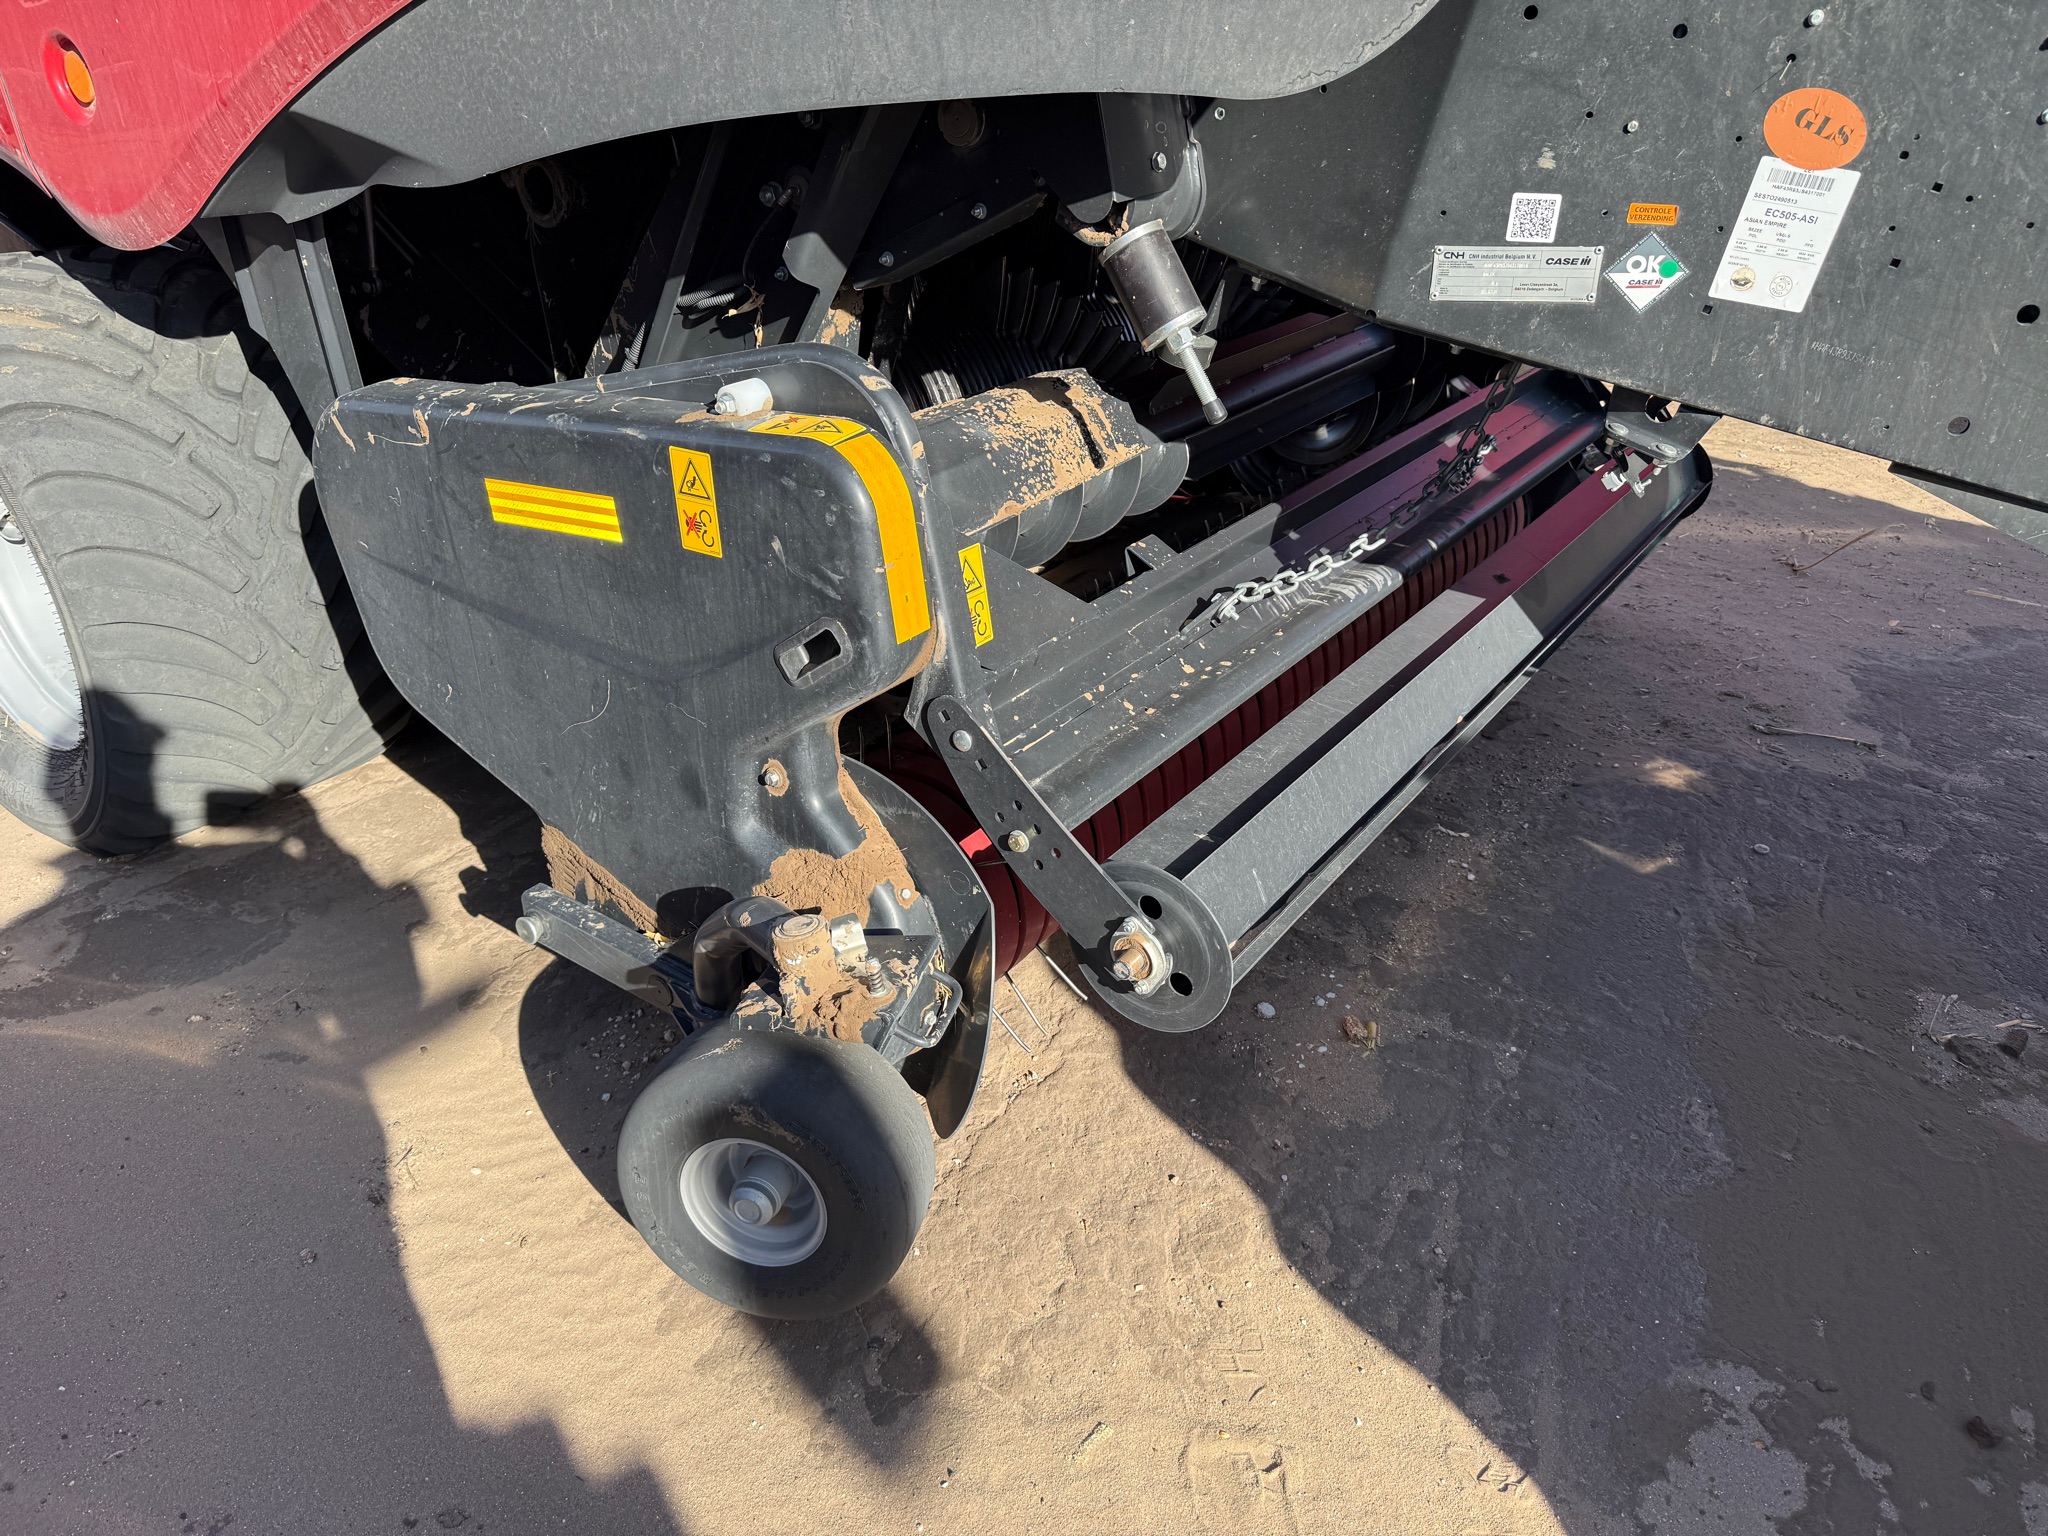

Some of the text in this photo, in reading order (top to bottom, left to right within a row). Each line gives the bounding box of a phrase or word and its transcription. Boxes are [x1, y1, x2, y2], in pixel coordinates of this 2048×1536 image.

[1795, 108, 1855, 147] GLS
[1635, 206, 1672, 215] CONTROLE
[1629, 214, 1674, 223] VERZENDING
[1764, 208, 1819, 225] EC505-ASI
[1744, 217, 1788, 229] ASIAN EMPIRE
[1444, 251, 1465, 260] CNH
[1545, 257, 1580, 266] CASE
[1626, 254, 1667, 273] OK
